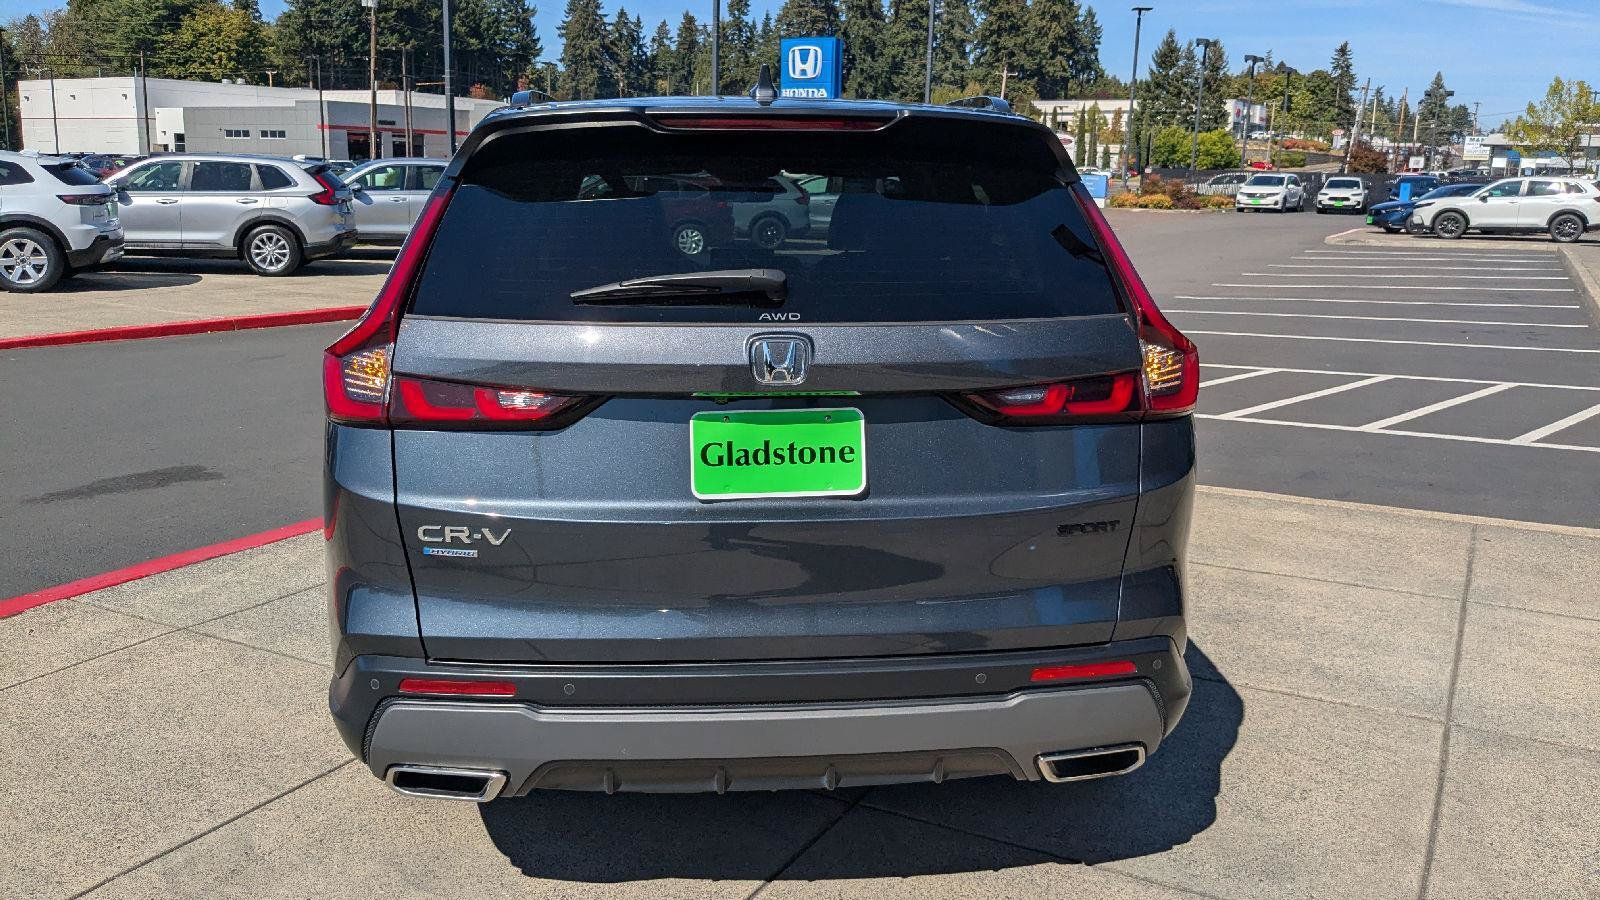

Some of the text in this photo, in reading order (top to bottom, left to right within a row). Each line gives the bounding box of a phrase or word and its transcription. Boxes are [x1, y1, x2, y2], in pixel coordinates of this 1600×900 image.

[781, 88, 828, 98] HONDA
[758, 312, 801, 321] AWD
[700, 439, 855, 467] Gladstone
[417, 525, 512, 546] CR-V
[1057, 520, 1120, 536] SPORT
